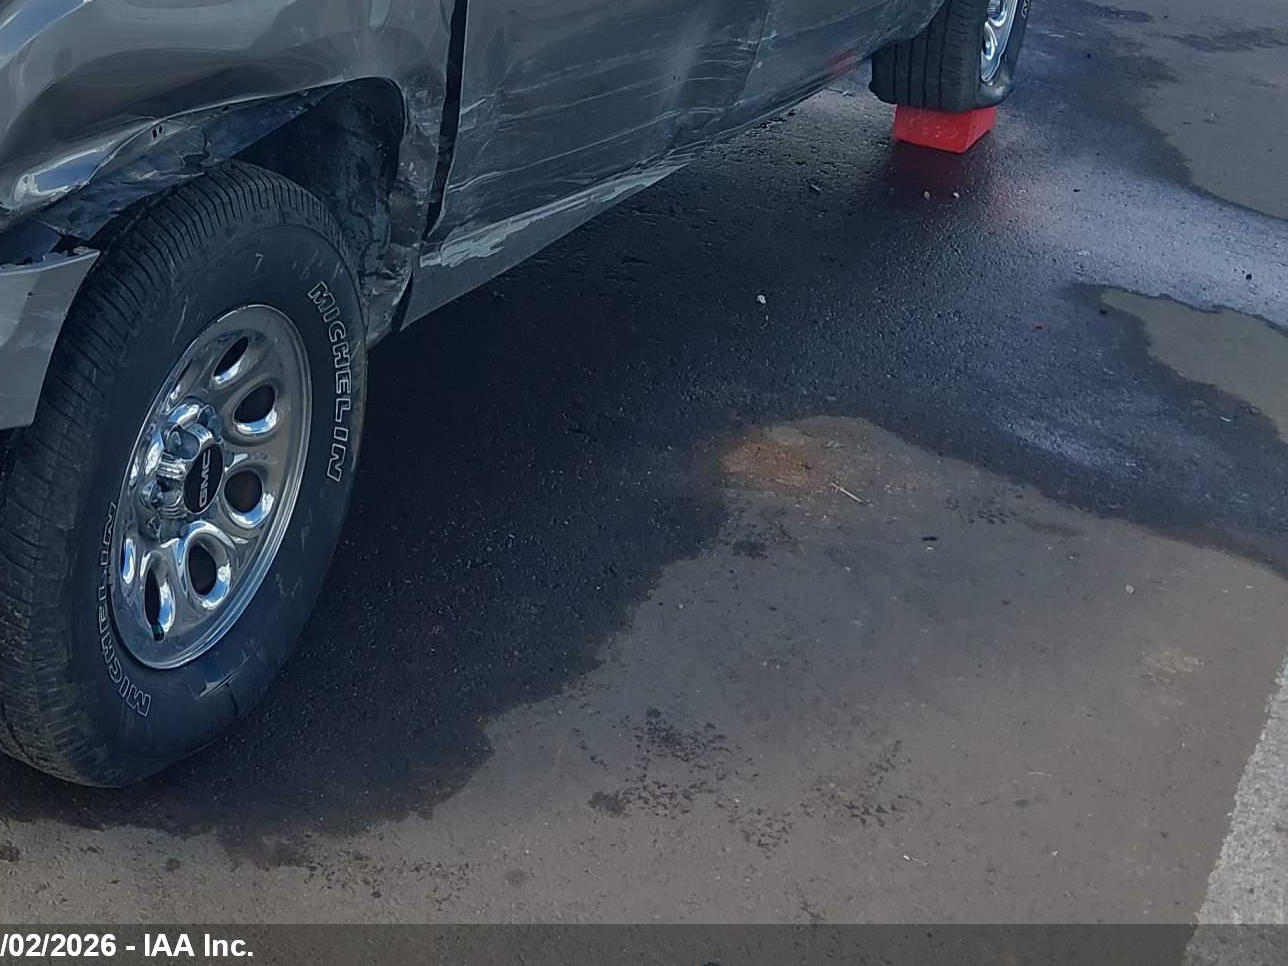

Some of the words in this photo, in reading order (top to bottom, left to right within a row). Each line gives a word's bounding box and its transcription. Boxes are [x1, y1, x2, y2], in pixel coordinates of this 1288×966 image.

[199, 448, 212, 509] GMC
[308, 282, 352, 482] MICHELIN
[97, 501, 152, 717] MICHELIN
